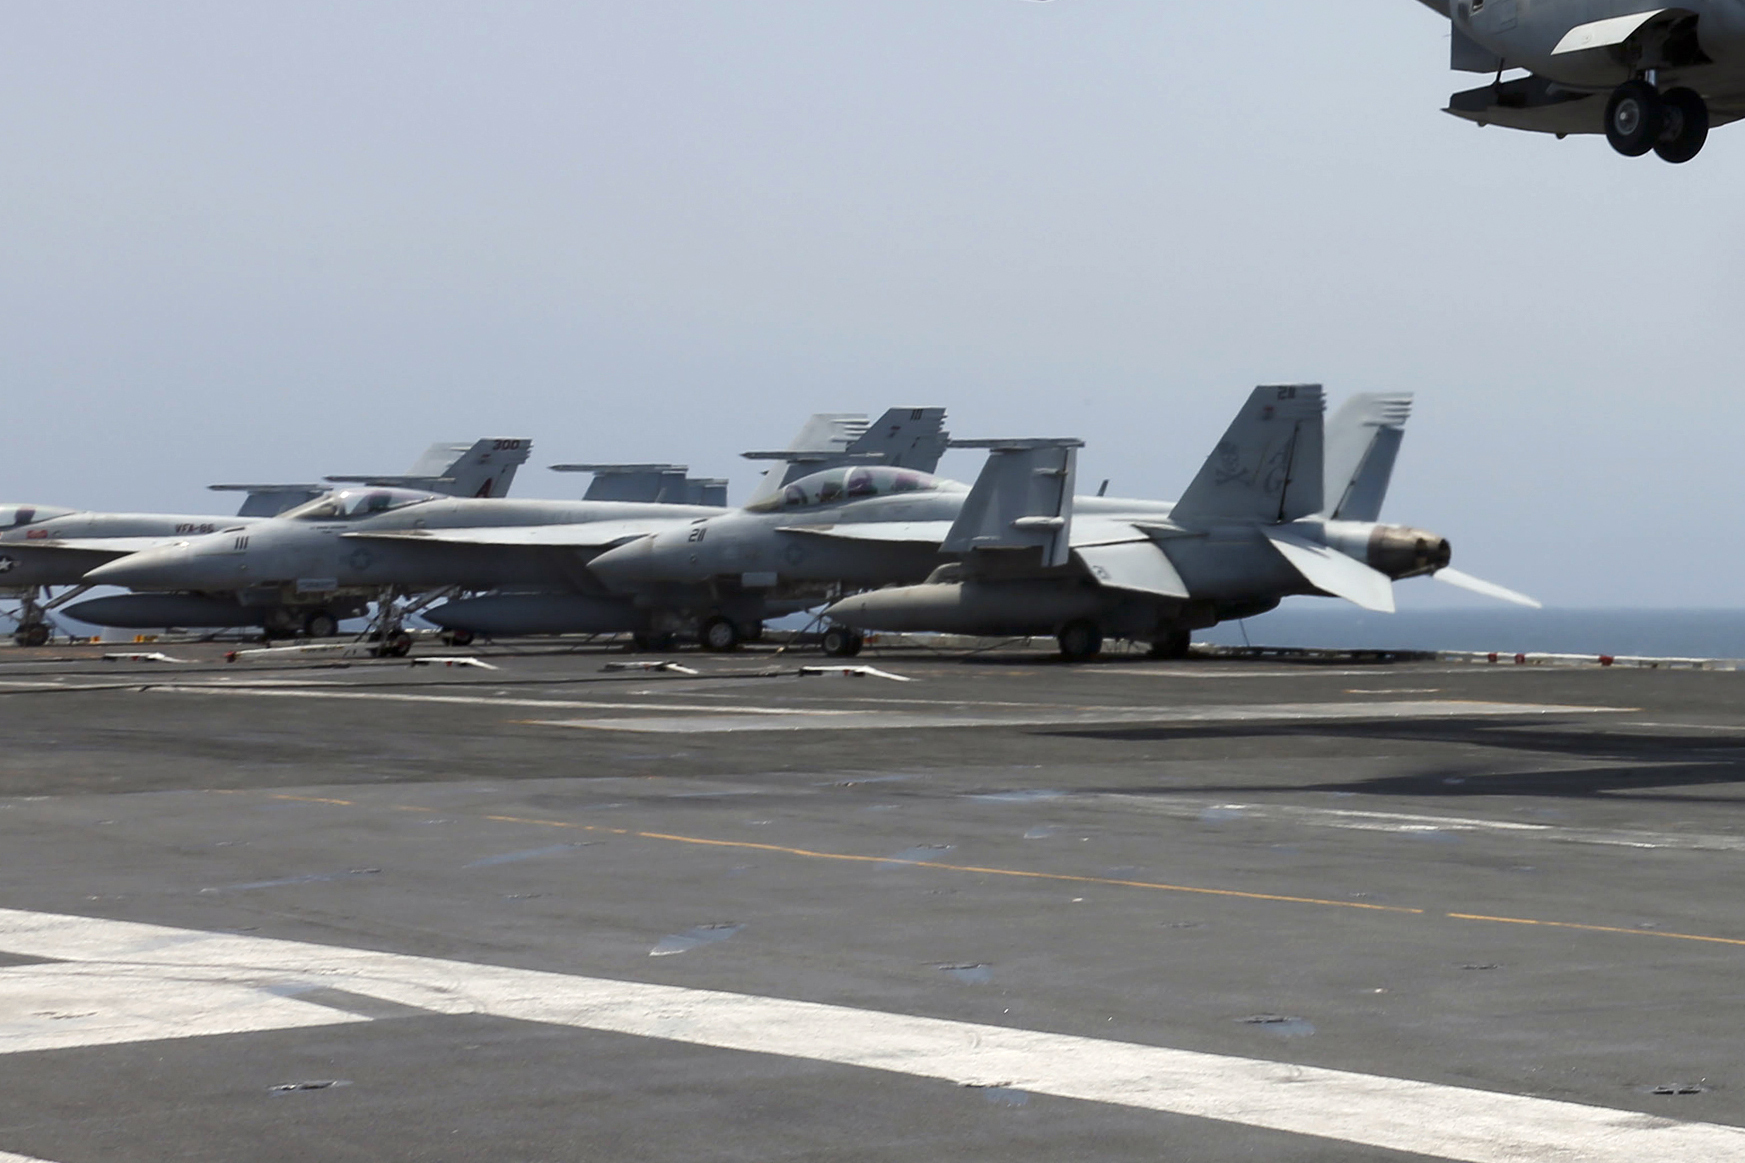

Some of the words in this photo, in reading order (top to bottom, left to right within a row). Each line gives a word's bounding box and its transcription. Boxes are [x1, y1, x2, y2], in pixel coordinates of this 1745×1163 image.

[493, 439, 521, 450] 300
[234, 535, 250, 550] 111
[688, 527, 708, 543] 211
